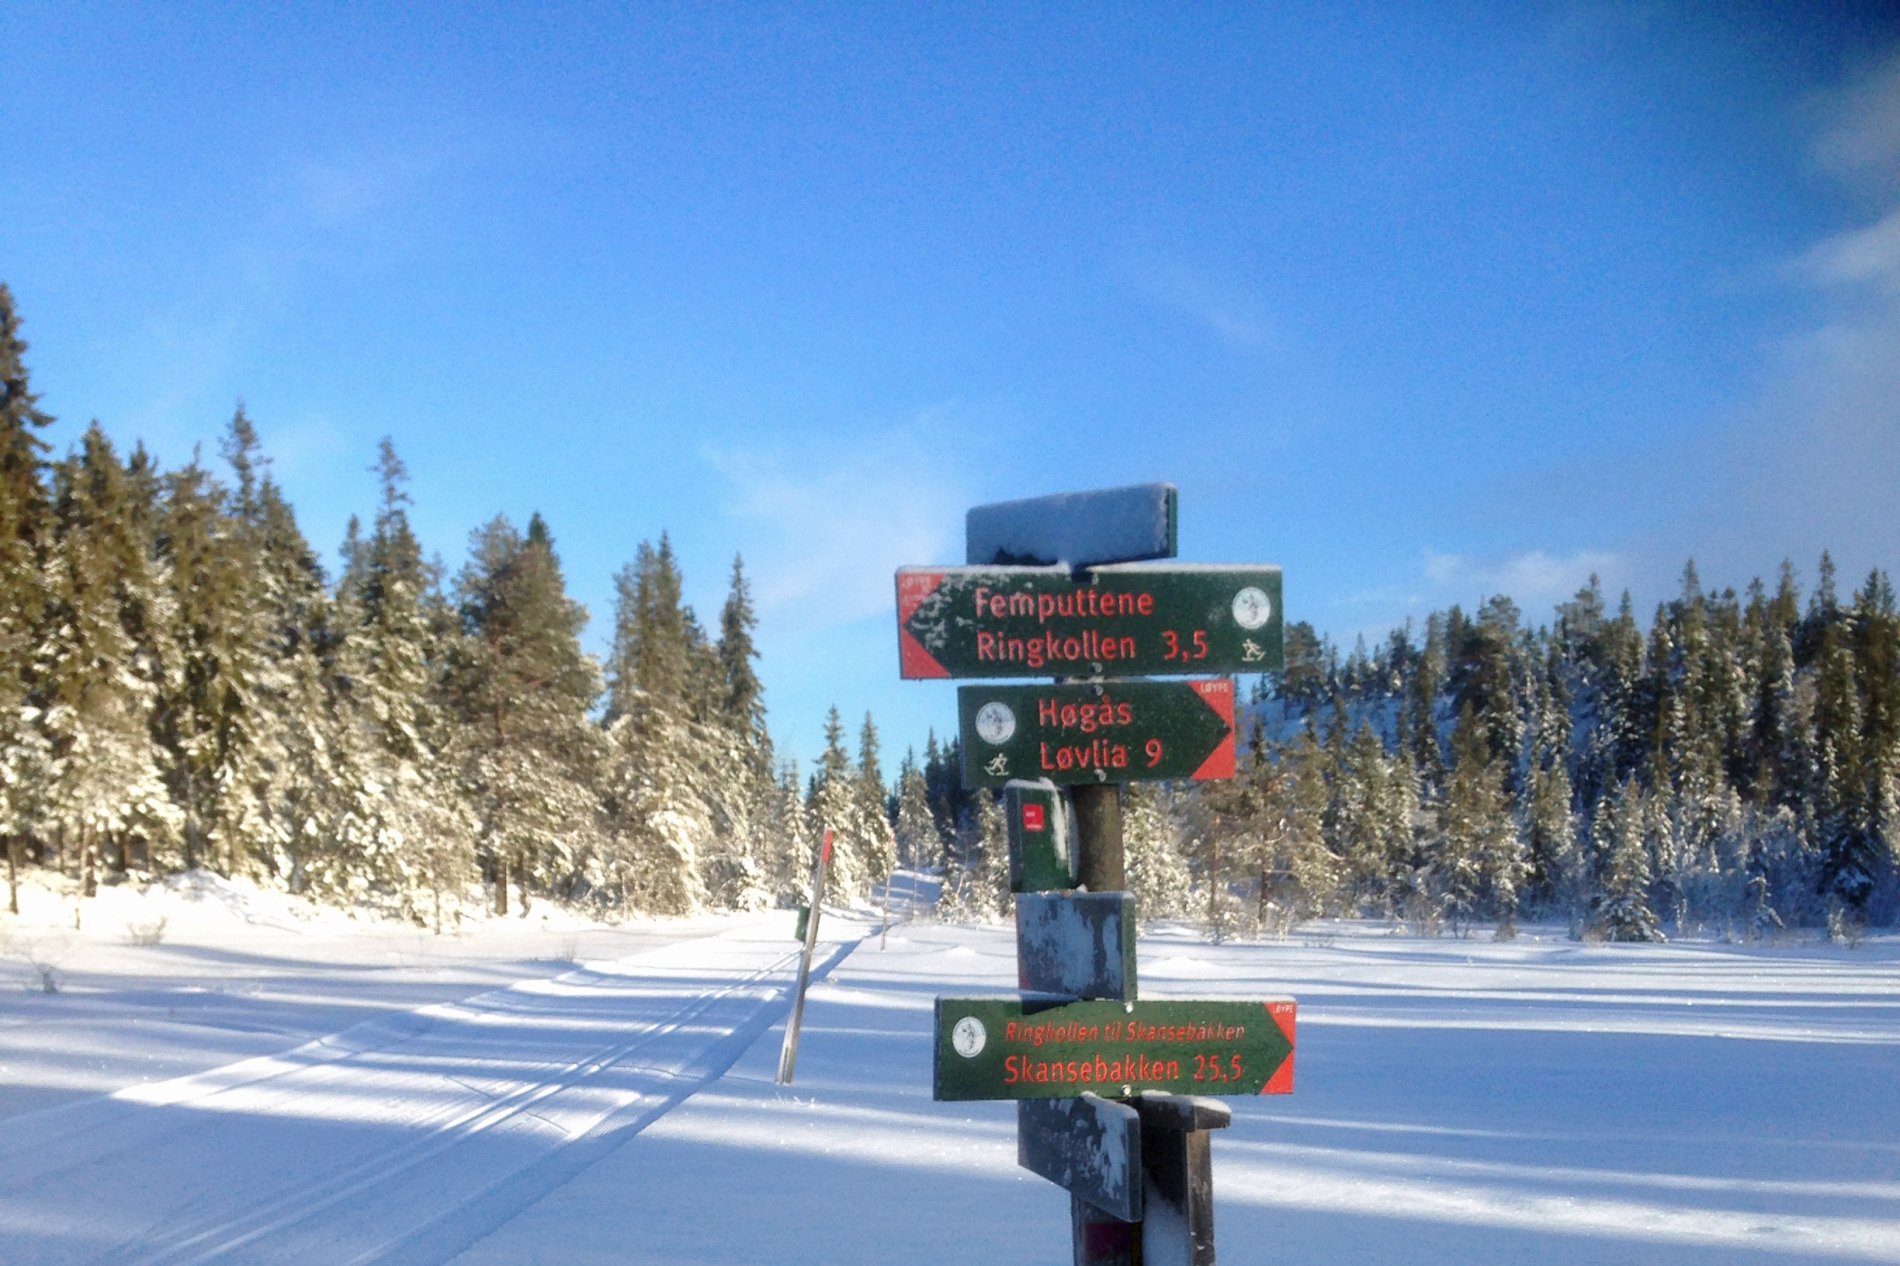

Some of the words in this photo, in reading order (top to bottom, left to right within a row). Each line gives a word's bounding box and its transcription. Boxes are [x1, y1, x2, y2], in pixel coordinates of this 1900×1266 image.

[974, 587, 1154, 622] Femputtene
[977, 629, 1136, 668] Ringkollen
[1162, 629, 1209, 662] 3,5
[1039, 694, 1133, 733] Høgås
[1040, 739, 1128, 771] Løvlia
[1145, 738, 1164, 769] 9
[1005, 1021, 1098, 1047] Ringkollen
[1103, 1021, 1122, 1042] til
[1125, 1020, 1246, 1043] Skansebakken
[1004, 1054, 1179, 1084] Skansebakken
[1192, 1054, 1244, 1084] 25,5
